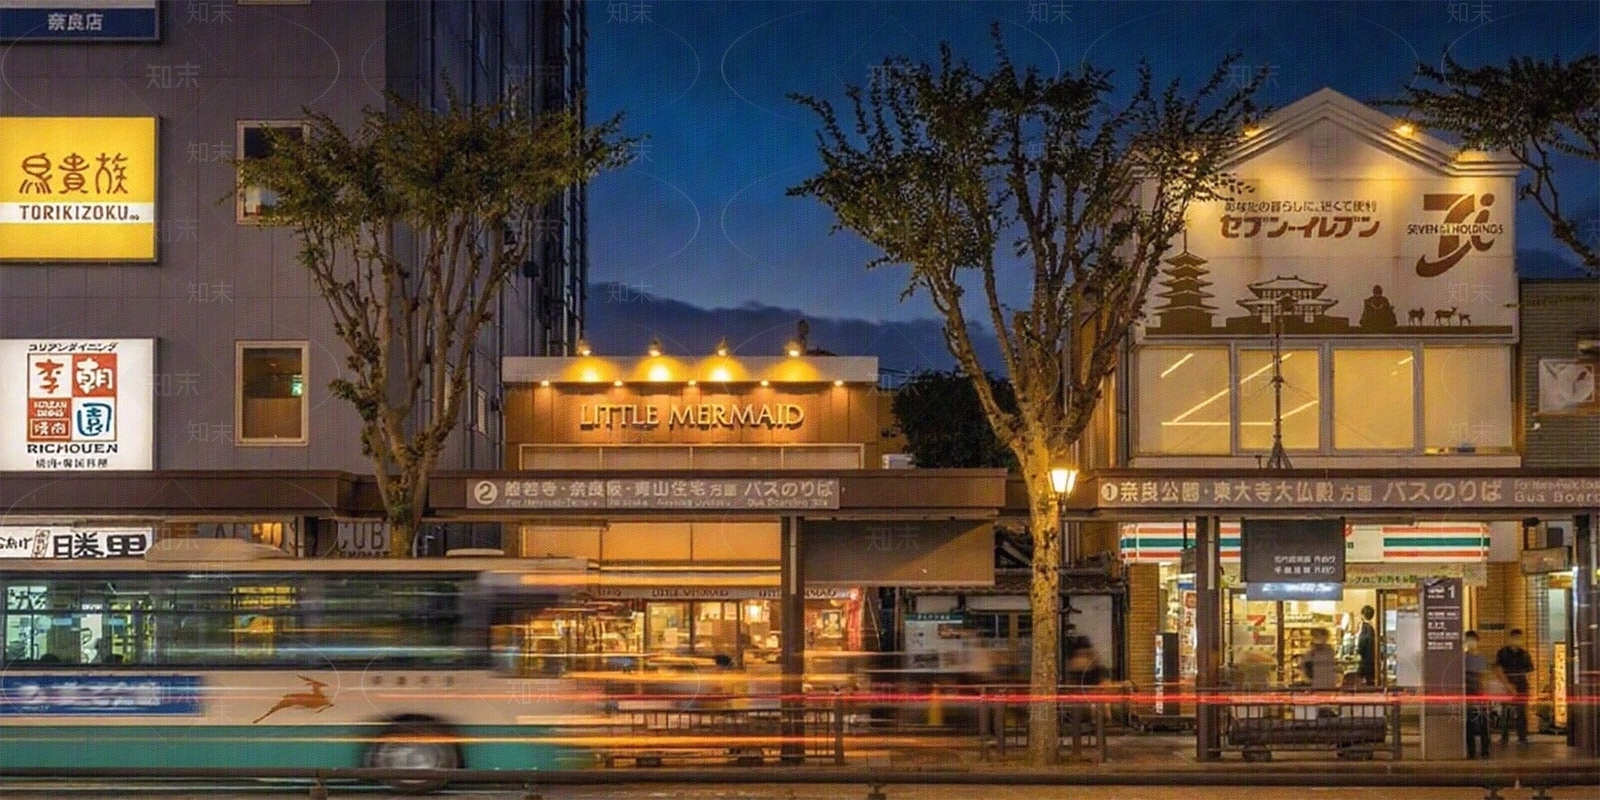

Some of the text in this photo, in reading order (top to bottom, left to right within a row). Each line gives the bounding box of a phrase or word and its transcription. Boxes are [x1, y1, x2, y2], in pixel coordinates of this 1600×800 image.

[48, 13, 104, 31] 奈良店
[19, 152, 129, 194] 鳥貴族
[19, 204, 129, 221] TORIKIZOKU
[580, 404, 805, 428] LITTLE MERMAID
[27, 443, 118, 454] RICHOUEN
[744, 480, 834, 497] バスのりば
[1383, 480, 1503, 501] バスのりば
